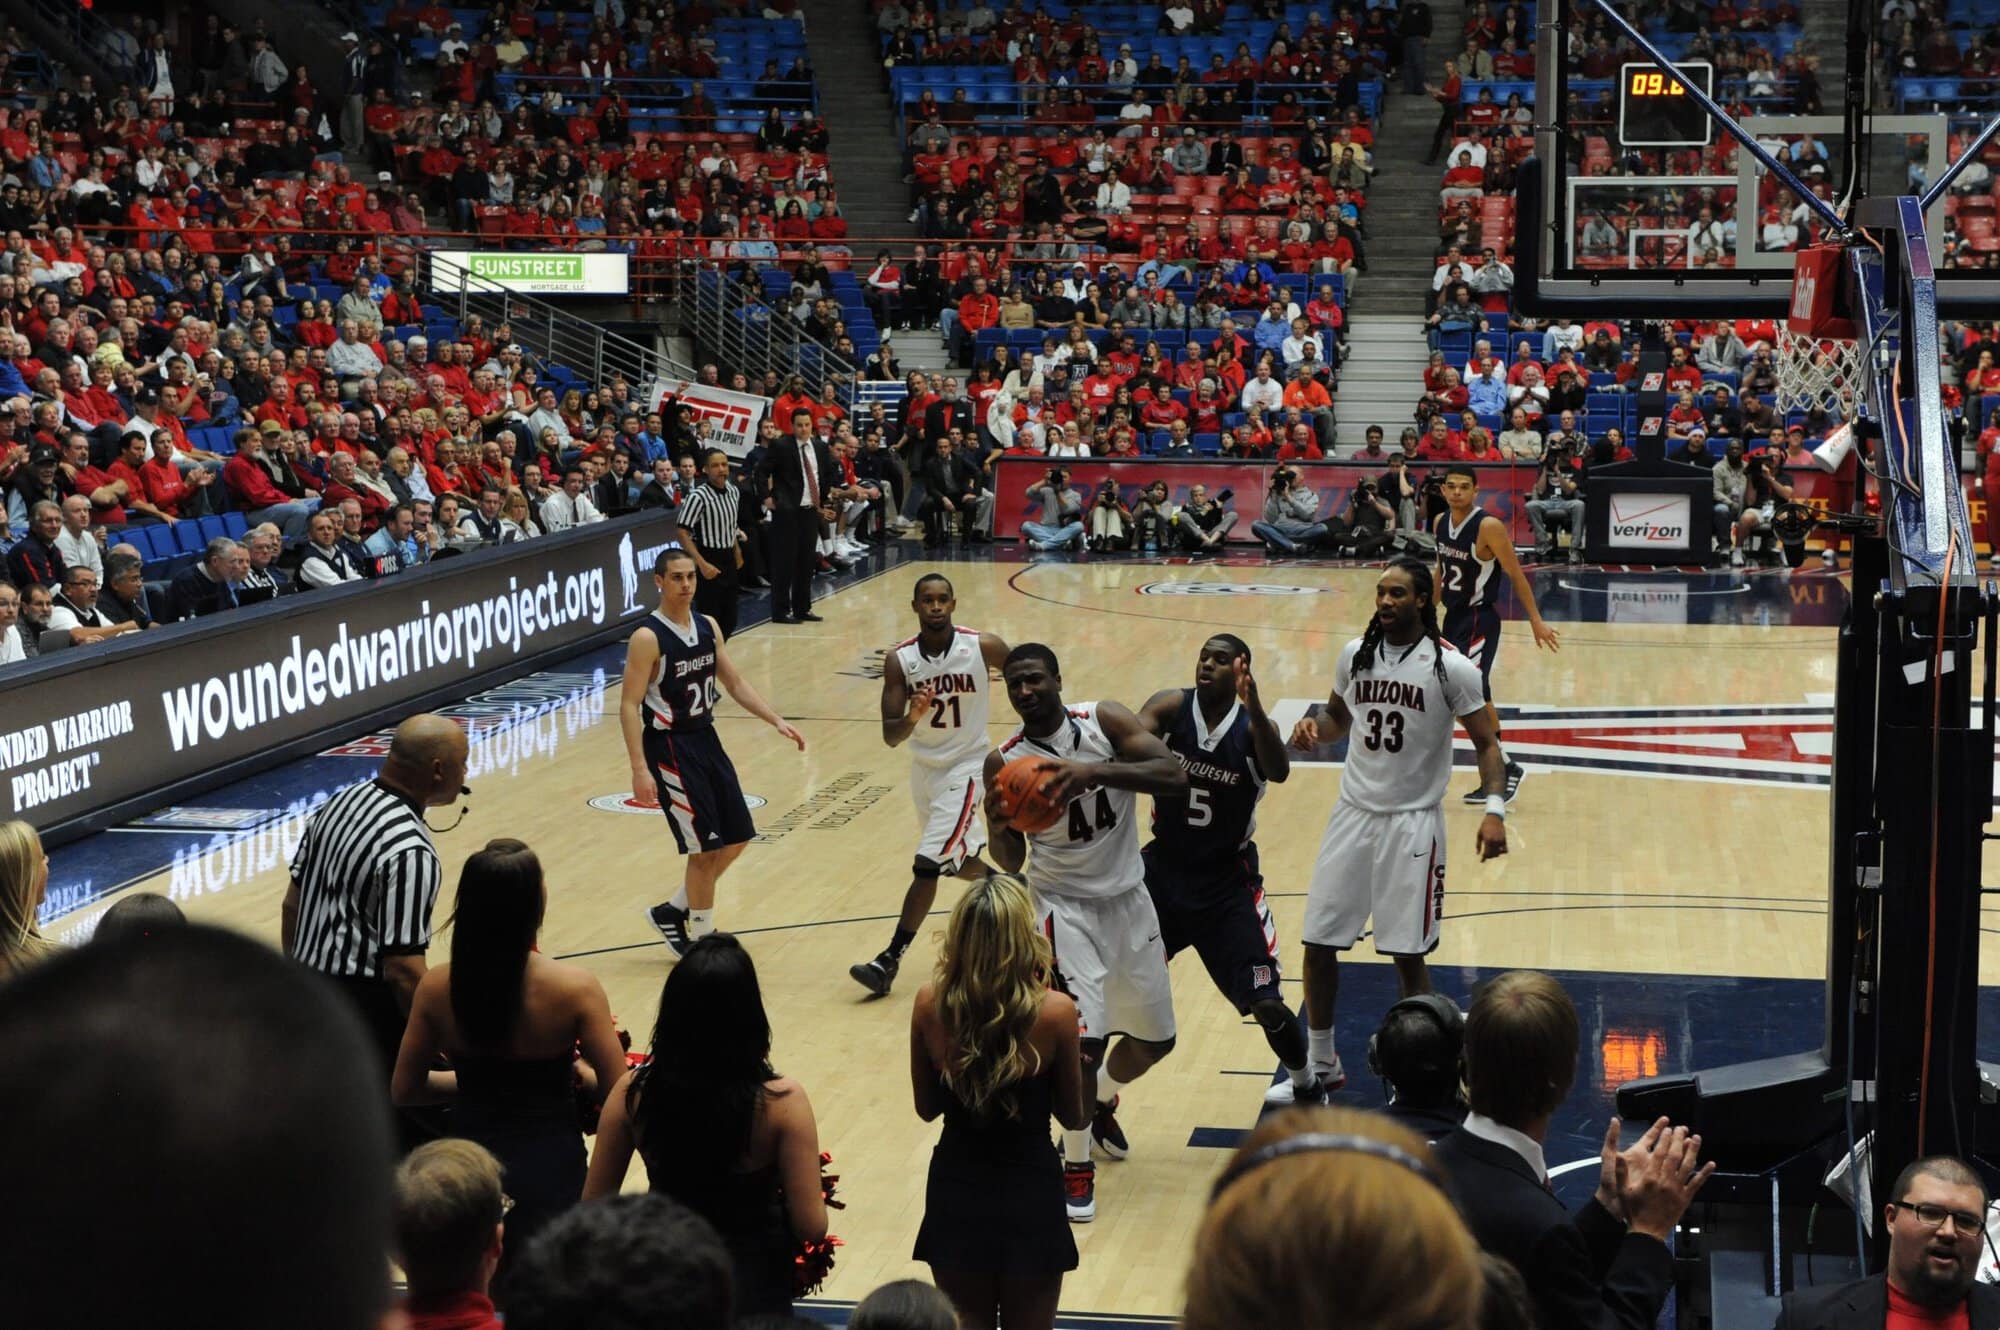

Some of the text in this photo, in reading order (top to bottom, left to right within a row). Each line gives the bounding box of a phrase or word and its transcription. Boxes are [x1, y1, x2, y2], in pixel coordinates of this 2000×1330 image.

[475, 260, 577, 276] SUNSTREET
[1613, 522, 1682, 540] verizon
[163, 567, 606, 752] woundedwarriorproject.org
[687, 675, 715, 717] 20
[930, 695, 961, 728] 21
[1355, 680, 1426, 712] ARIZONA
[51, 700, 134, 753] WARRIOR
[1364, 709, 1405, 753] 33
[1068, 785, 1117, 843] 44
[1188, 787, 1213, 827] 5
[1432, 864, 1446, 921] CATS
